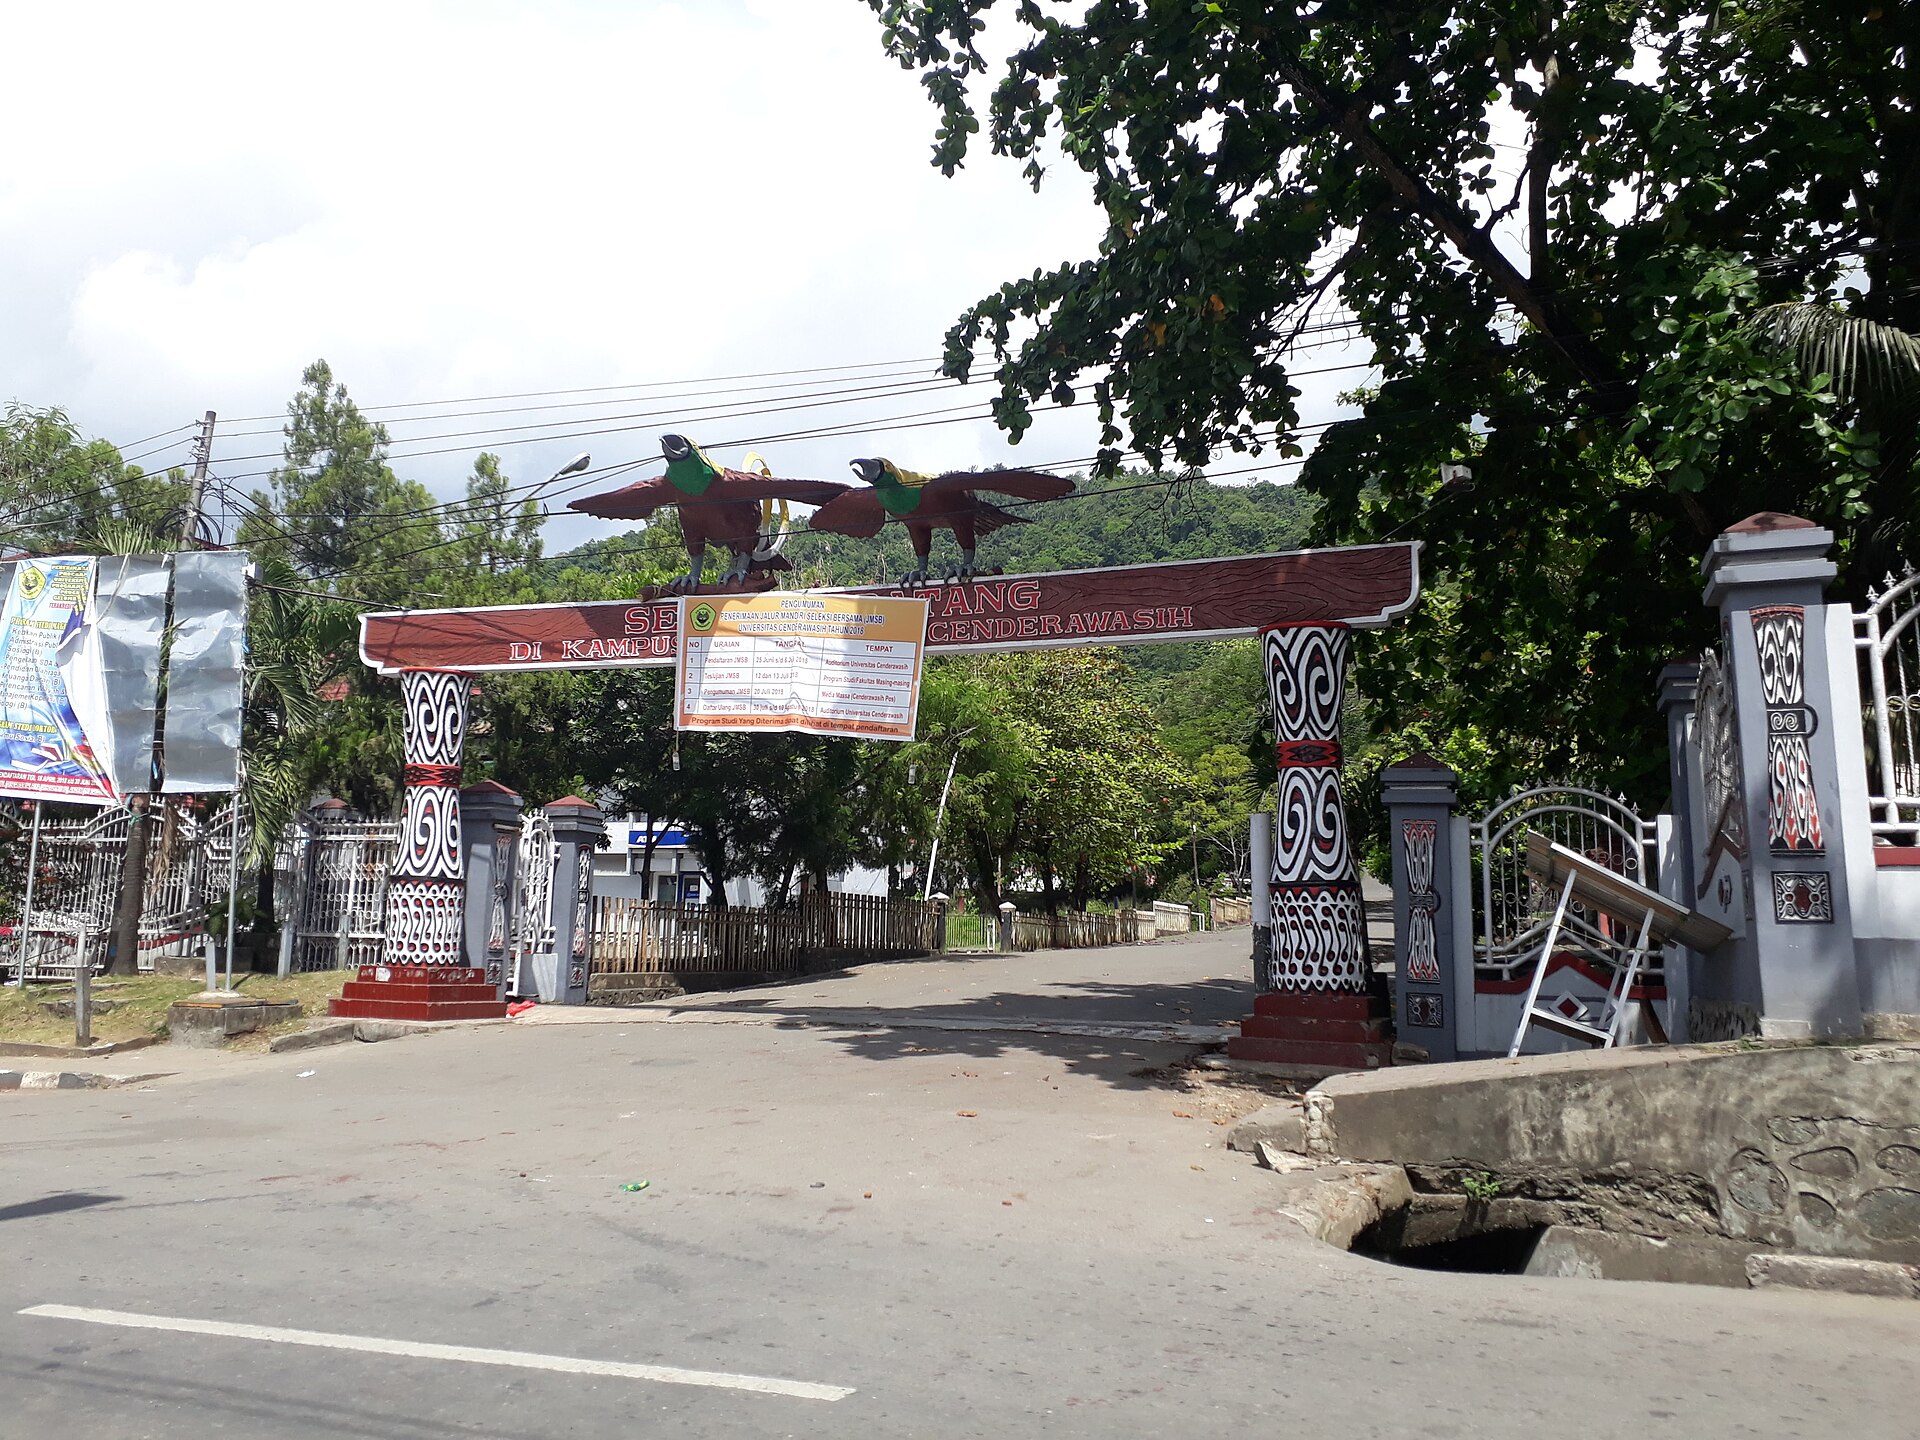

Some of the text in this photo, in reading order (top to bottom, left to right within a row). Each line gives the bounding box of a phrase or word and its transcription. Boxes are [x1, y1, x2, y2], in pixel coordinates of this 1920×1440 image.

[780, 600, 825, 609] PENGUMUMAN
[720, 612, 759, 621] PENERIMAAN
[759, 612, 780, 620] JALUR
[806, 612, 833, 622] SELEKSI
[834, 613, 863, 623] BERSAMA
[863, 615, 886, 626] (JMSB)
[509, 641, 542, 661] DI
[928, 606, 1194, 642] CENDERAWASIH
[738, 623, 778, 632] UNIVERSITAS
[828, 625, 849, 634] TAHUN
[849, 627, 865, 635] 2018
[865, 644, 894, 653] TEMPAT
[825, 659, 909, 670] Auditorium Universitas Cenderawasih
[820, 707, 904, 719] Auditorium Universitas Cenderawasih
[691, 718, 721, 726] Program
[738, 718, 755, 726] Yang
[829, 722, 855, 731] tempat
[855, 724, 899, 734] pendaftaran
